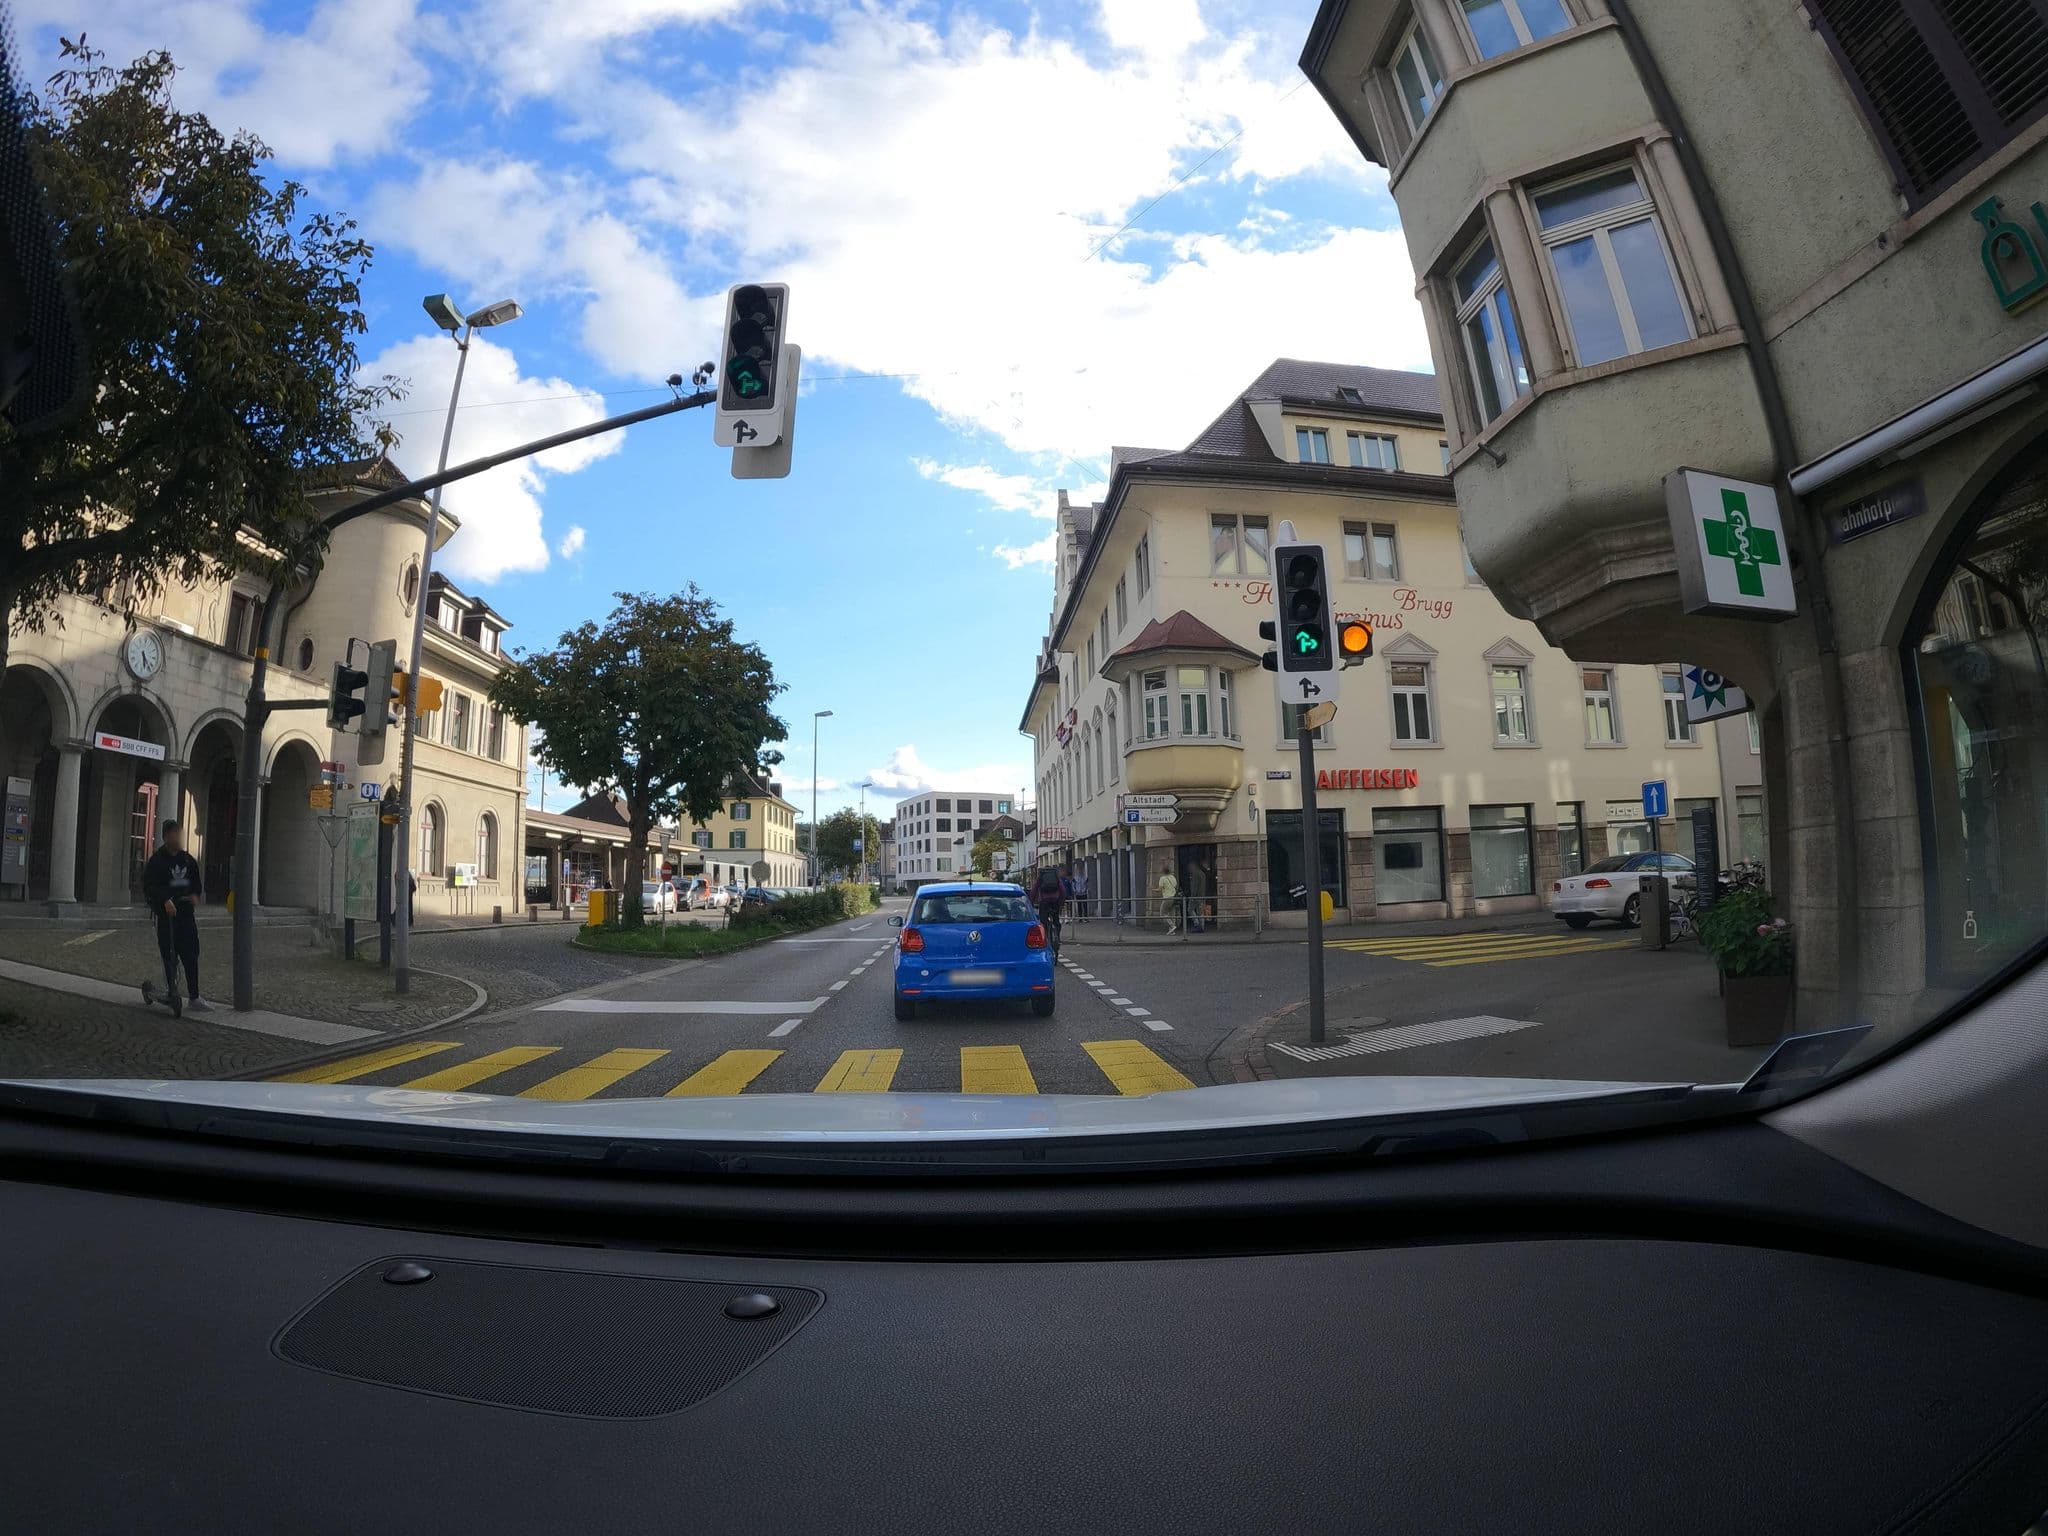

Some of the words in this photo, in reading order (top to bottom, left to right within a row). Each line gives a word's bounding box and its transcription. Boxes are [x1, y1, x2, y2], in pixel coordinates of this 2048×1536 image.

[1393, 588, 1453, 619] Brugg
[1316, 768, 1418, 789] AIFFEISEN
[1133, 796, 1165, 804] Altstadt
